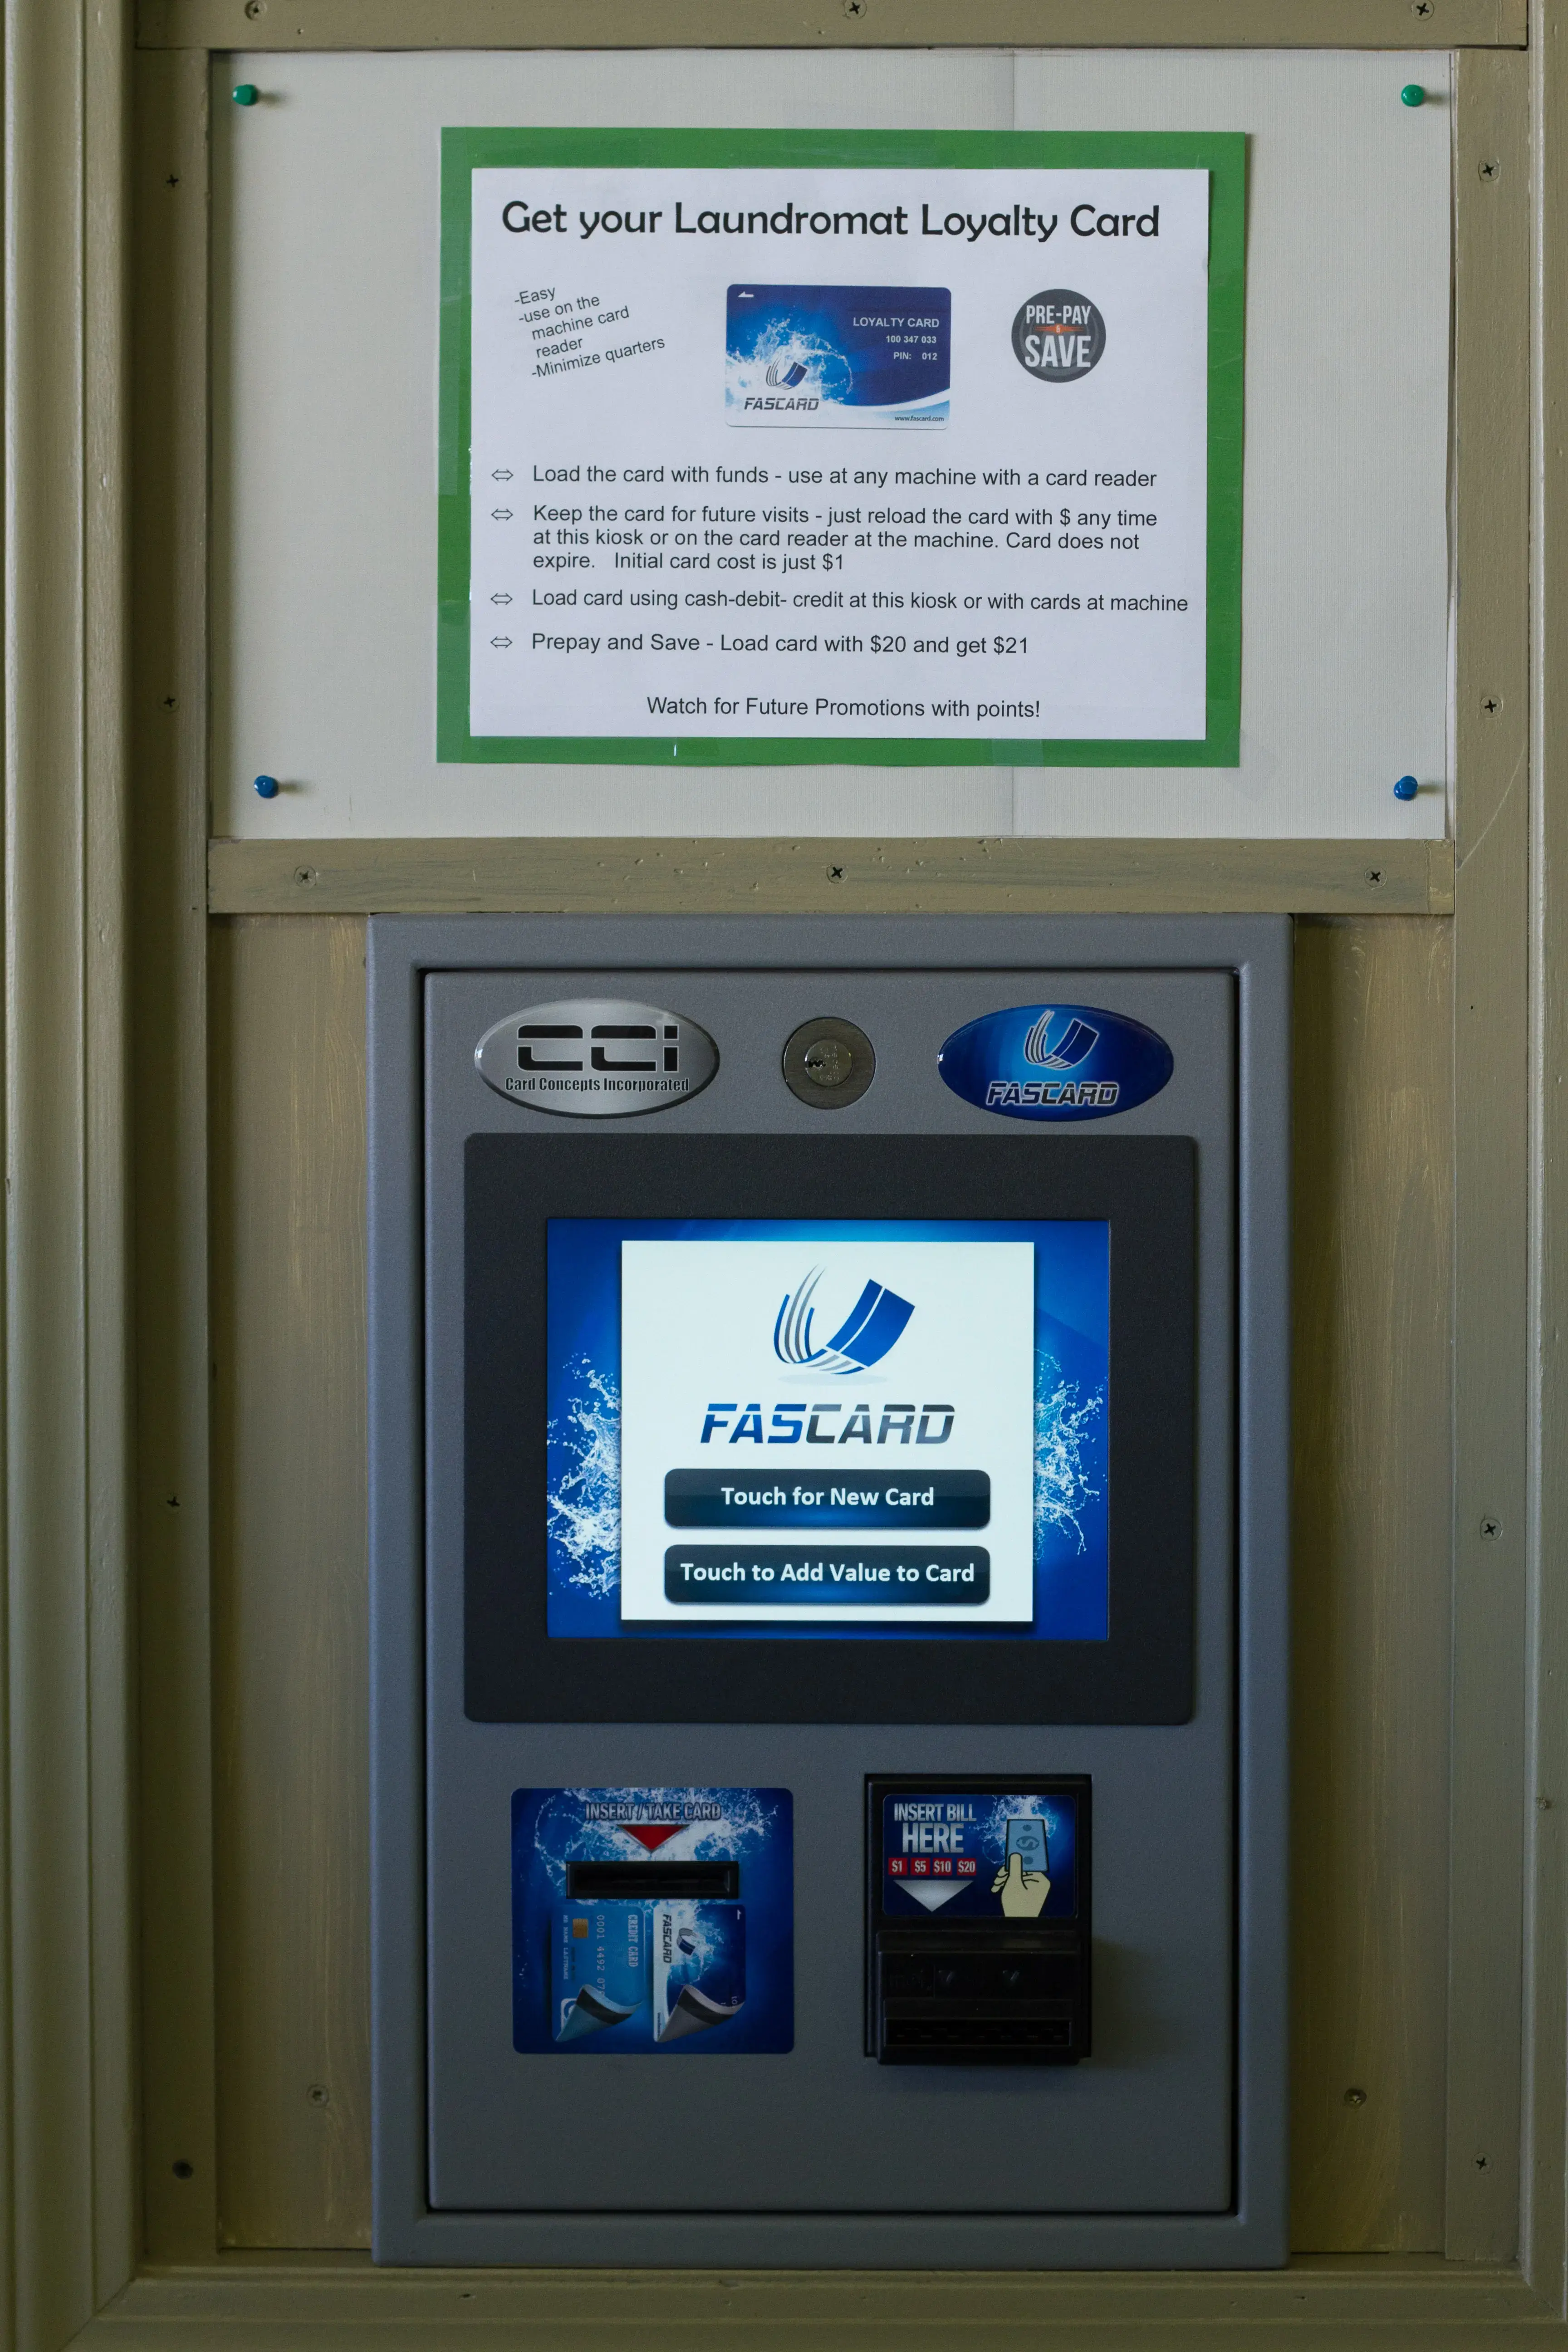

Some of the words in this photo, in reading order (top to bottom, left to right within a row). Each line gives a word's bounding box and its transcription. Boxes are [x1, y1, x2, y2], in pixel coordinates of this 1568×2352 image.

[502, 201, 568, 234] Get
[579, 211, 663, 240] your
[675, 202, 909, 235] Laundromat
[921, 204, 1058, 243] Loyalty
[1070, 204, 1160, 237] Card
[514, 287, 556, 305] -Easy
[519, 308, 550, 323] -use
[554, 303, 573, 315] on
[577, 296, 600, 310] the
[1026, 305, 1091, 324] PRE-PAY
[532, 317, 593, 340] machine
[598, 306, 630, 324] card
[853, 317, 904, 327] LOYALTY
[907, 318, 939, 328] CARD
[531, 353, 601, 377] -Minimize
[605, 338, 665, 363] quarters
[536, 338, 583, 358] reader
[893, 352, 912, 360] PIN:
[921, 352, 938, 360] 012
[1025, 335, 1091, 367] SAVE
[744, 397, 819, 411] FASCARD
[533, 465, 580, 482] Load
[586, 465, 617, 482] the
[623, 466, 664, 482] card
[671, 466, 709, 483] with
[715, 466, 769, 483] funds
[789, 470, 823, 484] use
[829, 468, 848, 484] at
[853, 471, 888, 489] any
[895, 468, 977, 485] machine
[982, 469, 1021, 485] with
[1027, 473, 1039, 485] a
[1045, 469, 1088, 486] card
[1094, 470, 1157, 487] reader
[534, 505, 583, 525] Keep
[588, 505, 618, 521] the
[624, 505, 665, 521] card
[671, 505, 697, 522] for
[701, 505, 756, 522] future
[762, 506, 809, 523] visits
[826, 507, 862, 527] just
[867, 507, 926, 524] reload
[932, 508, 962, 524] the
[968, 508, 1009, 524] card
[1014, 509, 1053, 525] with
[1059, 508, 1071, 527] $
[1077, 513, 1112, 530] any
[1117, 510, 1157, 526] time
[533, 529, 551, 544] at
[556, 528, 589, 544] this
[596, 529, 644, 545] kiosk
[650, 533, 669, 545] or
[674, 533, 697, 545] on
[703, 529, 734, 546] the
[739, 530, 780, 546] card
[787, 530, 849, 547] reader
[854, 531, 872, 547] at
[877, 531, 907, 547] the
[914, 531, 999, 548] machine.
[1006, 532, 1051, 549] Card
[1058, 532, 1104, 549] does
[1110, 534, 1140, 550] not
[533, 552, 595, 572] expire.
[615, 552, 663, 568] Initial
[669, 553, 710, 569] card
[716, 554, 756, 569] cost
[762, 553, 777, 569] is
[781, 554, 816, 574] just
[822, 553, 843, 572] $1
[533, 589, 577, 606] Load
[583, 589, 623, 606] card
[630, 589, 678, 610] using
[684, 590, 787, 607] cash-debit-
[793, 591, 844, 608] credit
[849, 592, 867, 608] at
[872, 591, 905, 608] this
[911, 592, 958, 609] kiosk
[963, 596, 983, 609] or
[987, 593, 1024, 609] with
[1030, 593, 1081, 610] cards
[1087, 594, 1105, 610] at
[1110, 594, 1188, 612] machine
[532, 633, 601, 654] Prepay
[607, 633, 643, 650] and
[650, 633, 701, 651] Save
[720, 634, 769, 651] Load
[775, 635, 818, 652] card
[823, 635, 863, 652] with
[870, 634, 906, 654] $20
[913, 636, 949, 653] and
[956, 637, 987, 657] get
[993, 636, 1028, 656] $21
[646, 696, 707, 714] Watch
[713, 697, 740, 715] for
[746, 697, 808, 715] Future
[815, 698, 925, 716] Promotions
[931, 699, 970, 717] with
[976, 700, 1040, 721] points!
[505, 1077, 536, 1091] Card
[539, 1077, 601, 1092] Concepts
[603, 1078, 690, 1093] Incorporated
[985, 1081, 1119, 1105] FASCARD
[700, 1403, 956, 1445] FASCARD
[720, 1486, 787, 1505] Touch
[792, 1486, 825, 1505] for
[830, 1488, 880, 1505] New
[885, 1487, 934, 1505] Card
[680, 1562, 746, 1581] Touch
[751, 1565, 775, 1581] to
[780, 1562, 823, 1581] Add
[829, 1563, 891, 1582] Value
[896, 1565, 920, 1582] to
[925, 1563, 975, 1582] Card
[586, 1803, 635, 1820] INSERT
[637, 1803, 644, 1820] /
[646, 1803, 681, 1820] TAKE
[684, 1803, 721, 1820] CARD
[894, 1803, 944, 1821] INSERT
[947, 1803, 977, 1821] BILL
[902, 1823, 964, 1853] HERE
[892, 1859, 902, 1872] $1
[915, 1860, 926, 1873] $5
[934, 1860, 951, 1873] $10
[958, 1860, 975, 1873] $20
[597, 1915, 605, 1940] 0001
[627, 1914, 638, 1943] CREDIT
[662, 1914, 672, 1964] FASCARD
[597, 1946, 605, 1971] 4492
[628, 1946, 638, 1967] CARD
